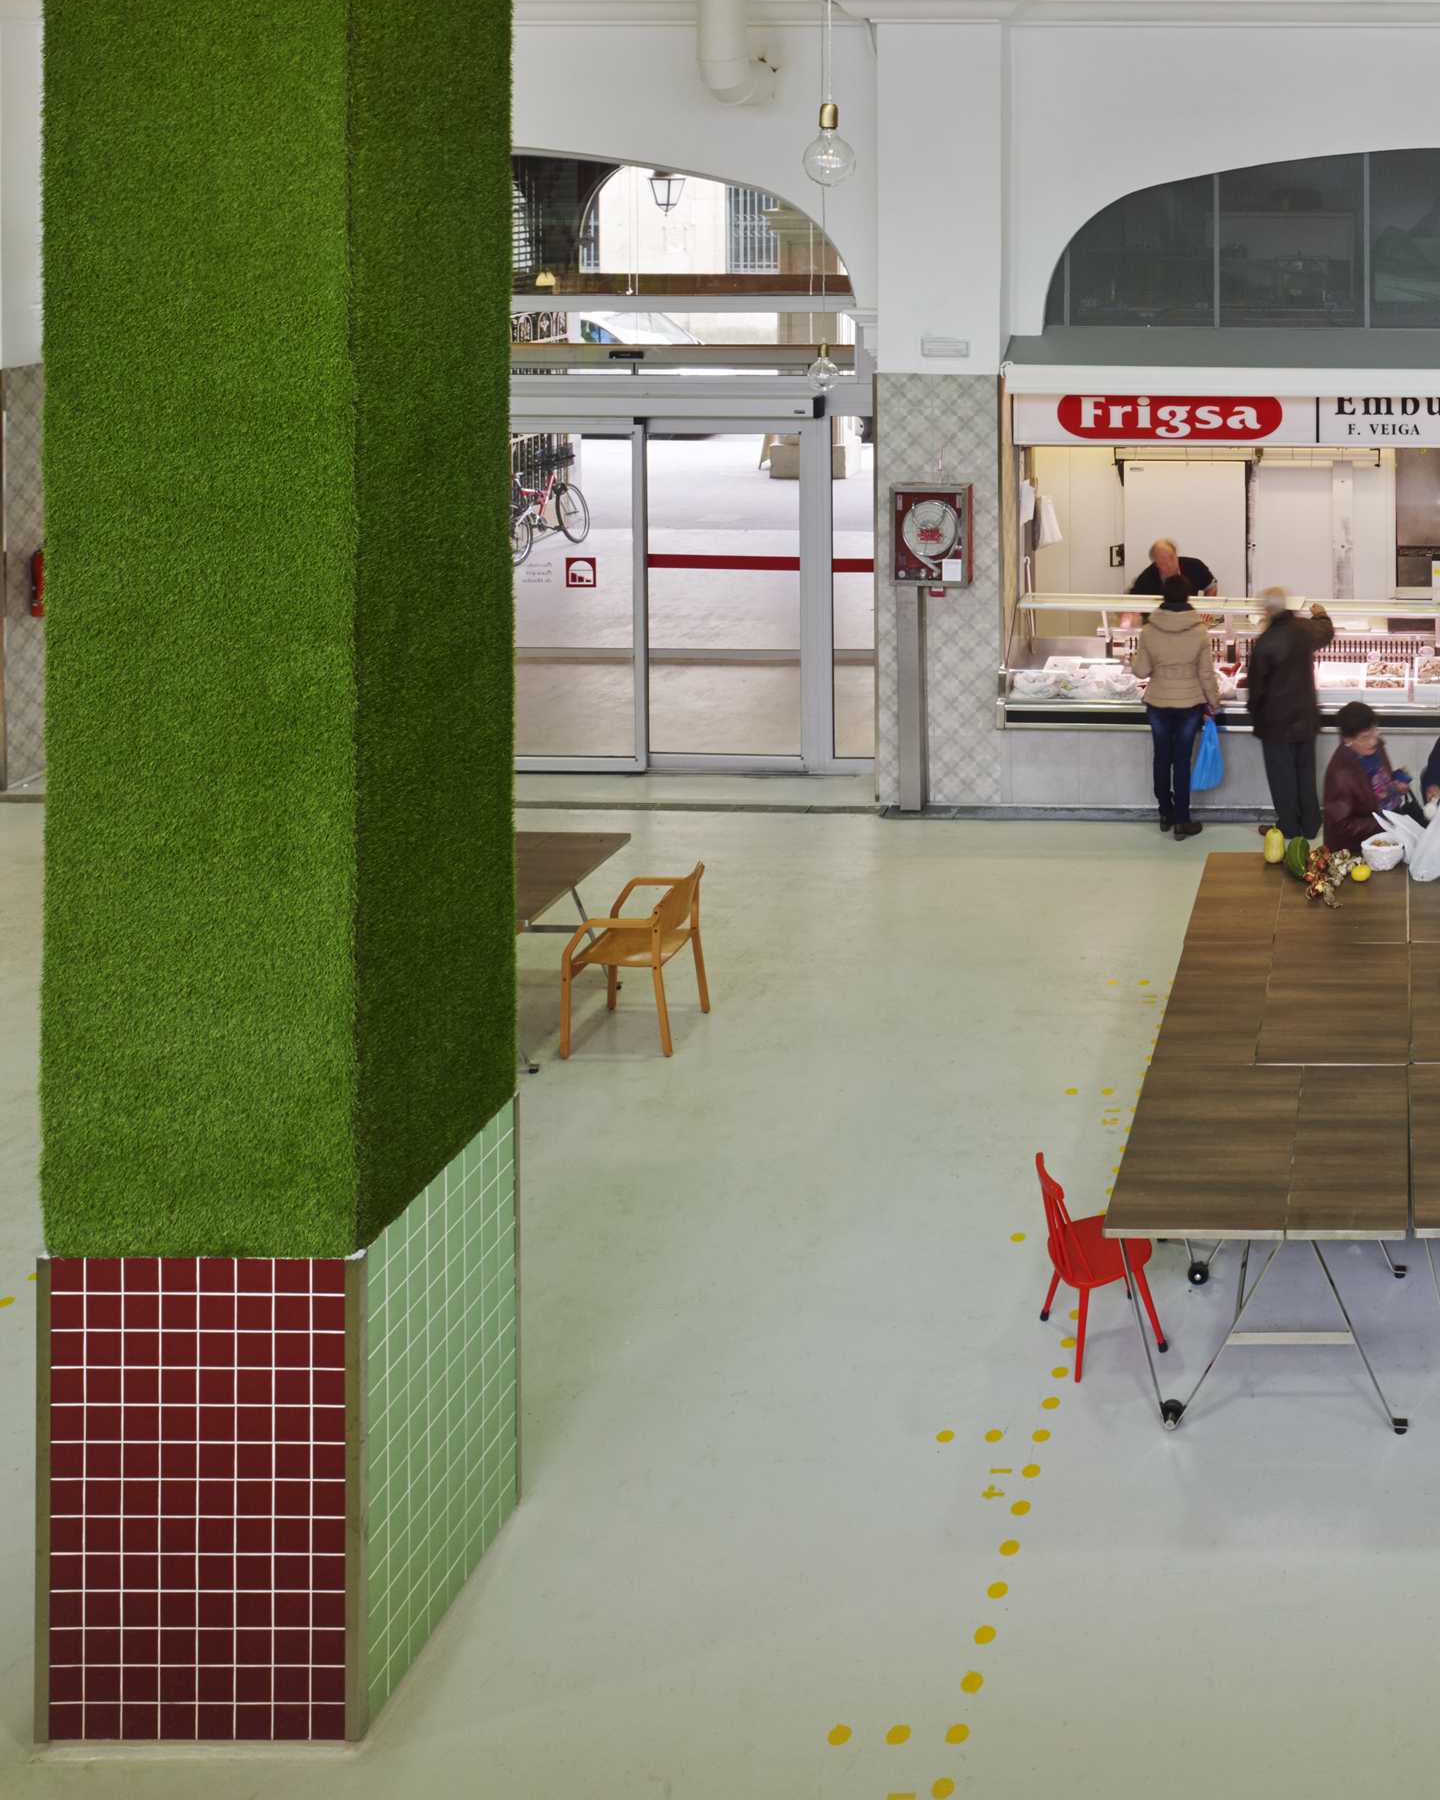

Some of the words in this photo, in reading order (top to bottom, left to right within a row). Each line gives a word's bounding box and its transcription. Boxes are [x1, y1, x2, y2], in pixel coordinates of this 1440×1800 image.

[1080, 397, 1262, 438] Frigsa
[1348, 424, 1361, 436] F.
[1369, 424, 1421, 436] VEIGA
